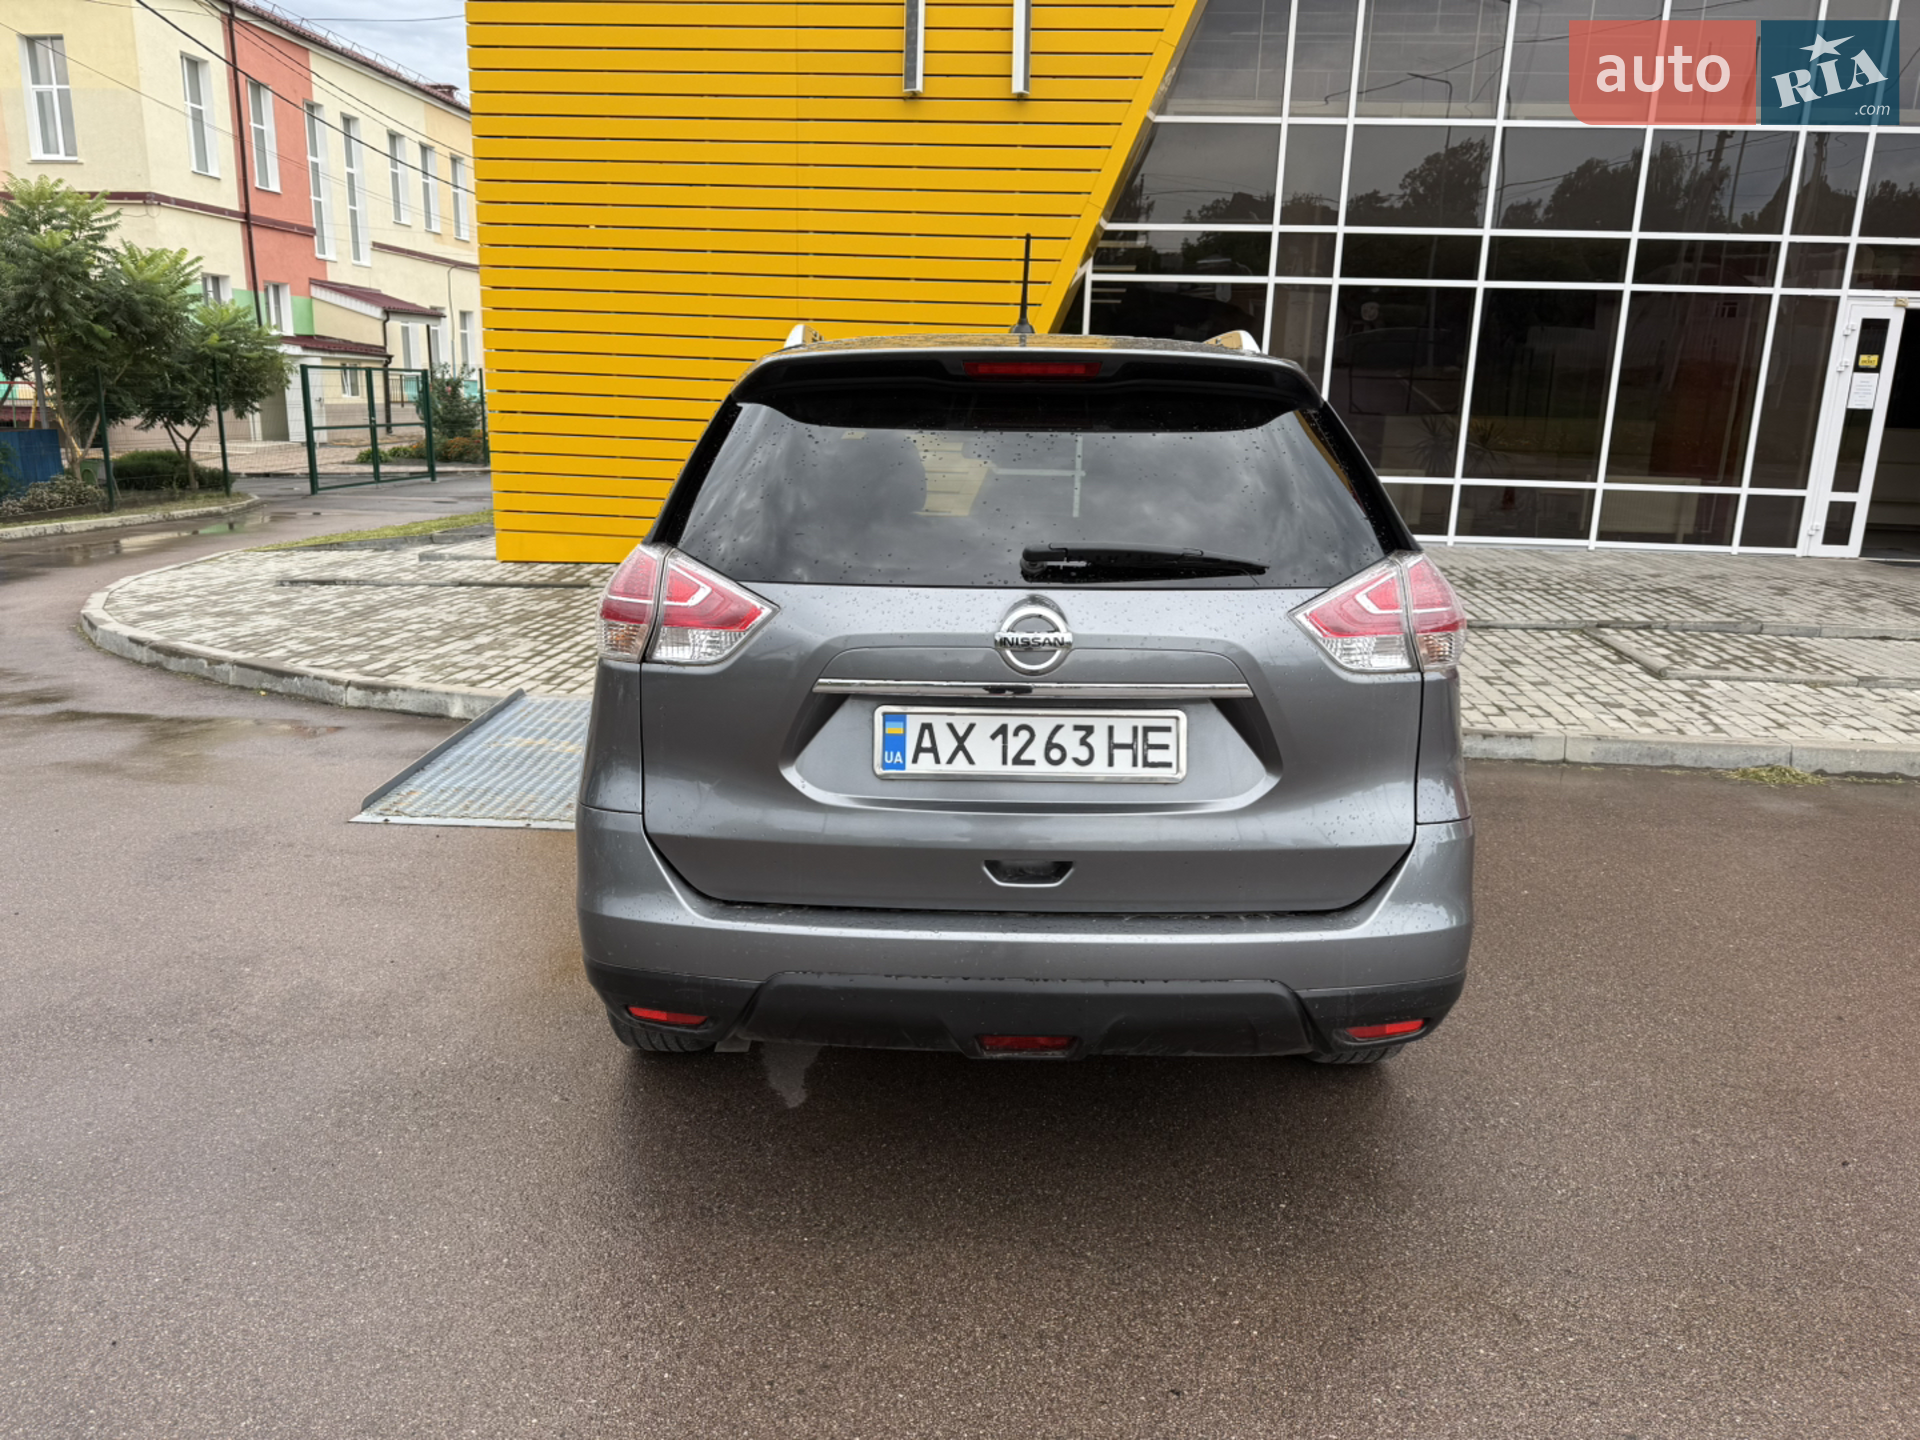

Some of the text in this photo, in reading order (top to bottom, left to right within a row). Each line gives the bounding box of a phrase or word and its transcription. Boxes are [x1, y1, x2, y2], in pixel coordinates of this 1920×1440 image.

[1003, 636, 1065, 648] NISSAN
[911, 722, 1173, 768] AX 1263 HE
[884, 751, 904, 764] UA
